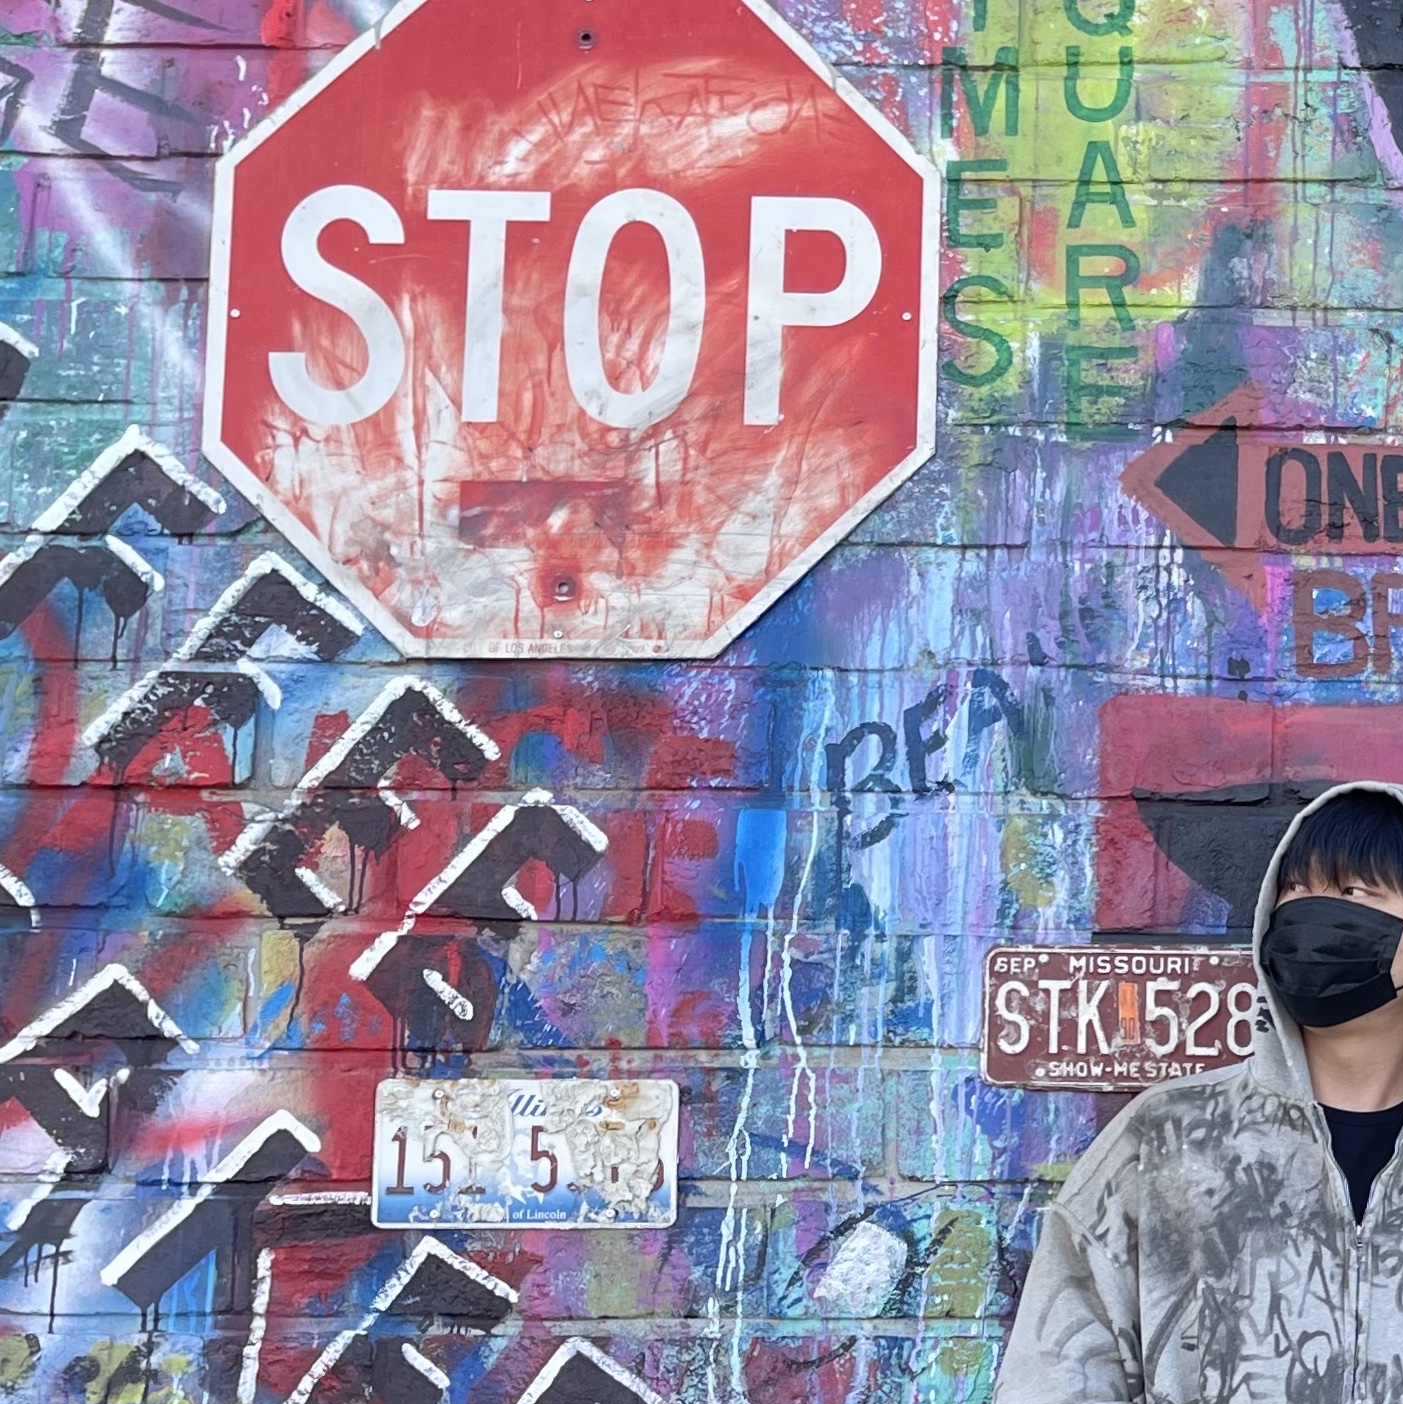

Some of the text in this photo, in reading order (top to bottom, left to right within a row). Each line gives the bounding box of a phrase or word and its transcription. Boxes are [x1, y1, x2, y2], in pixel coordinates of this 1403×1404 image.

[268, 183, 884, 429] STOP
[505, 643, 523, 655] LOS
[527, 643, 571, 655] ANGELES
[1069, 955, 1190, 974] MISSOURI
[995, 979, 1111, 1054] STK
[1048, 1062, 1205, 1077] SHOW-ME STATE
[512, 1209, 567, 1220] of Lincoln
